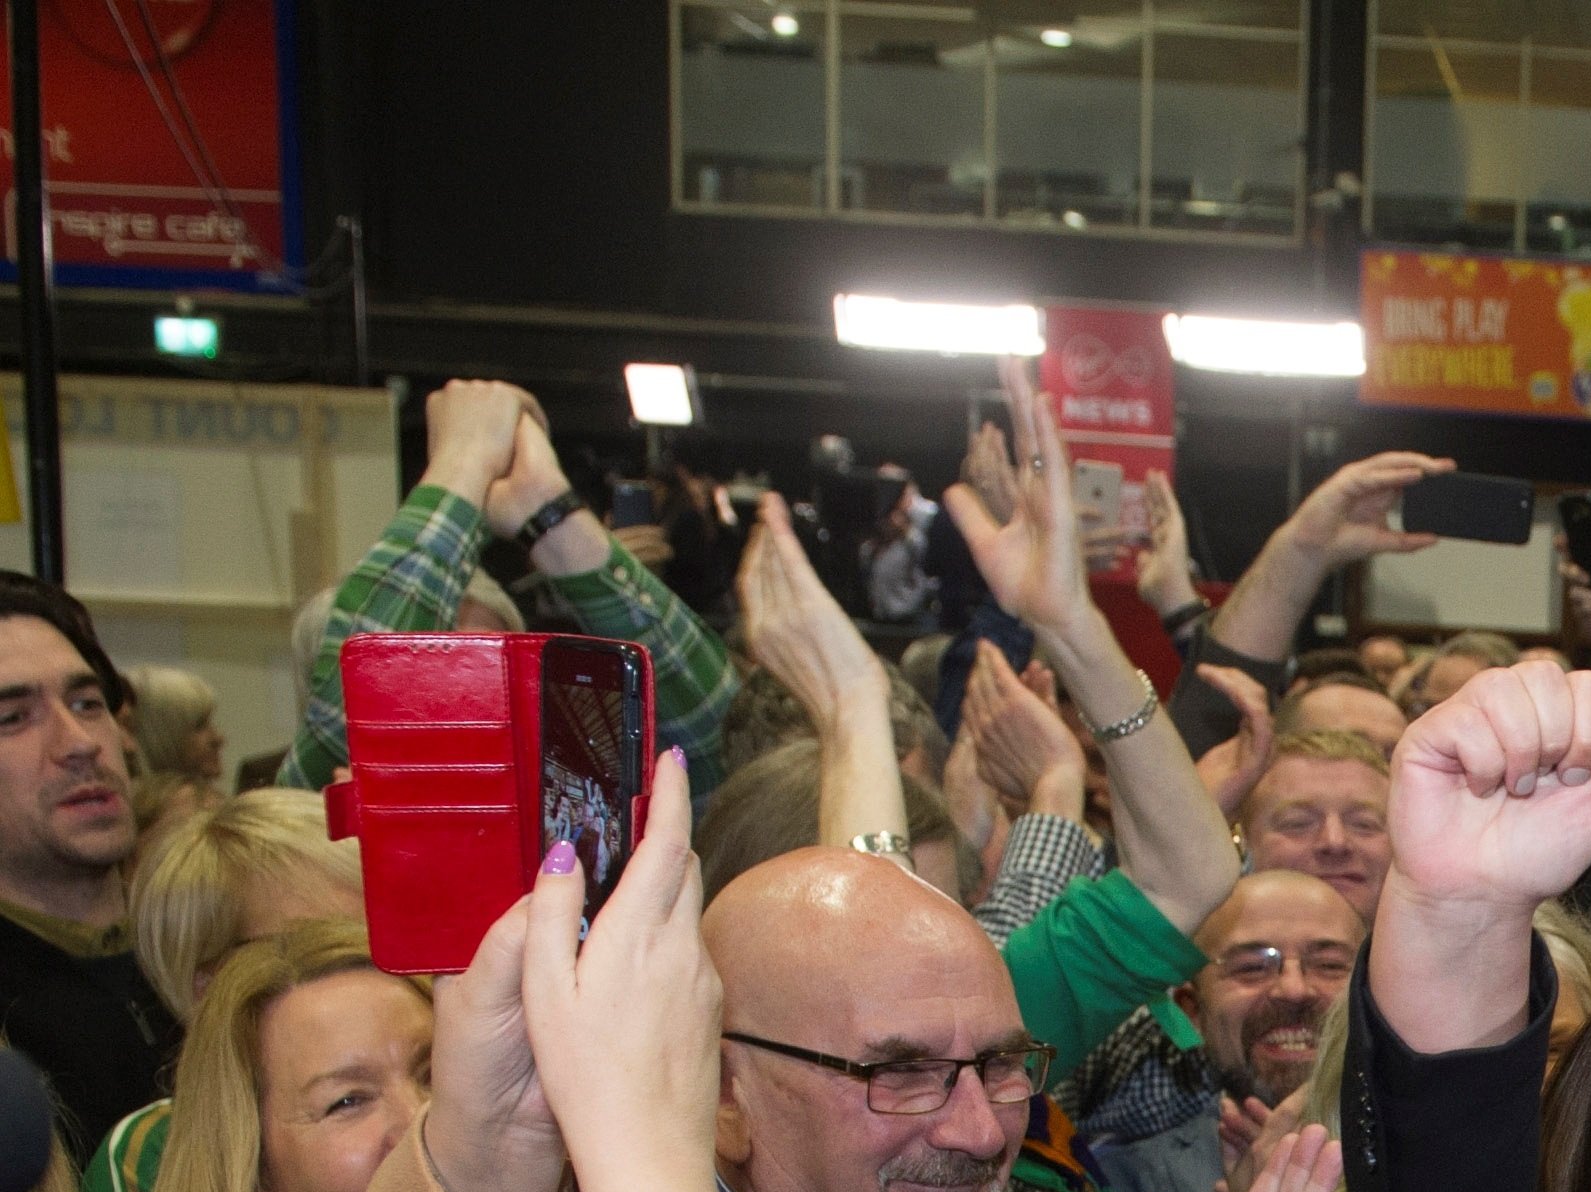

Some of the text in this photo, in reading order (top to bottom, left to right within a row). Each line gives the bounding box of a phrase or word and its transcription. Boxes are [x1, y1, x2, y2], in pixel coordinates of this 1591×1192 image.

[1382, 297, 1510, 343] BRING PLAY
[1059, 395, 1152, 427] NEWS
